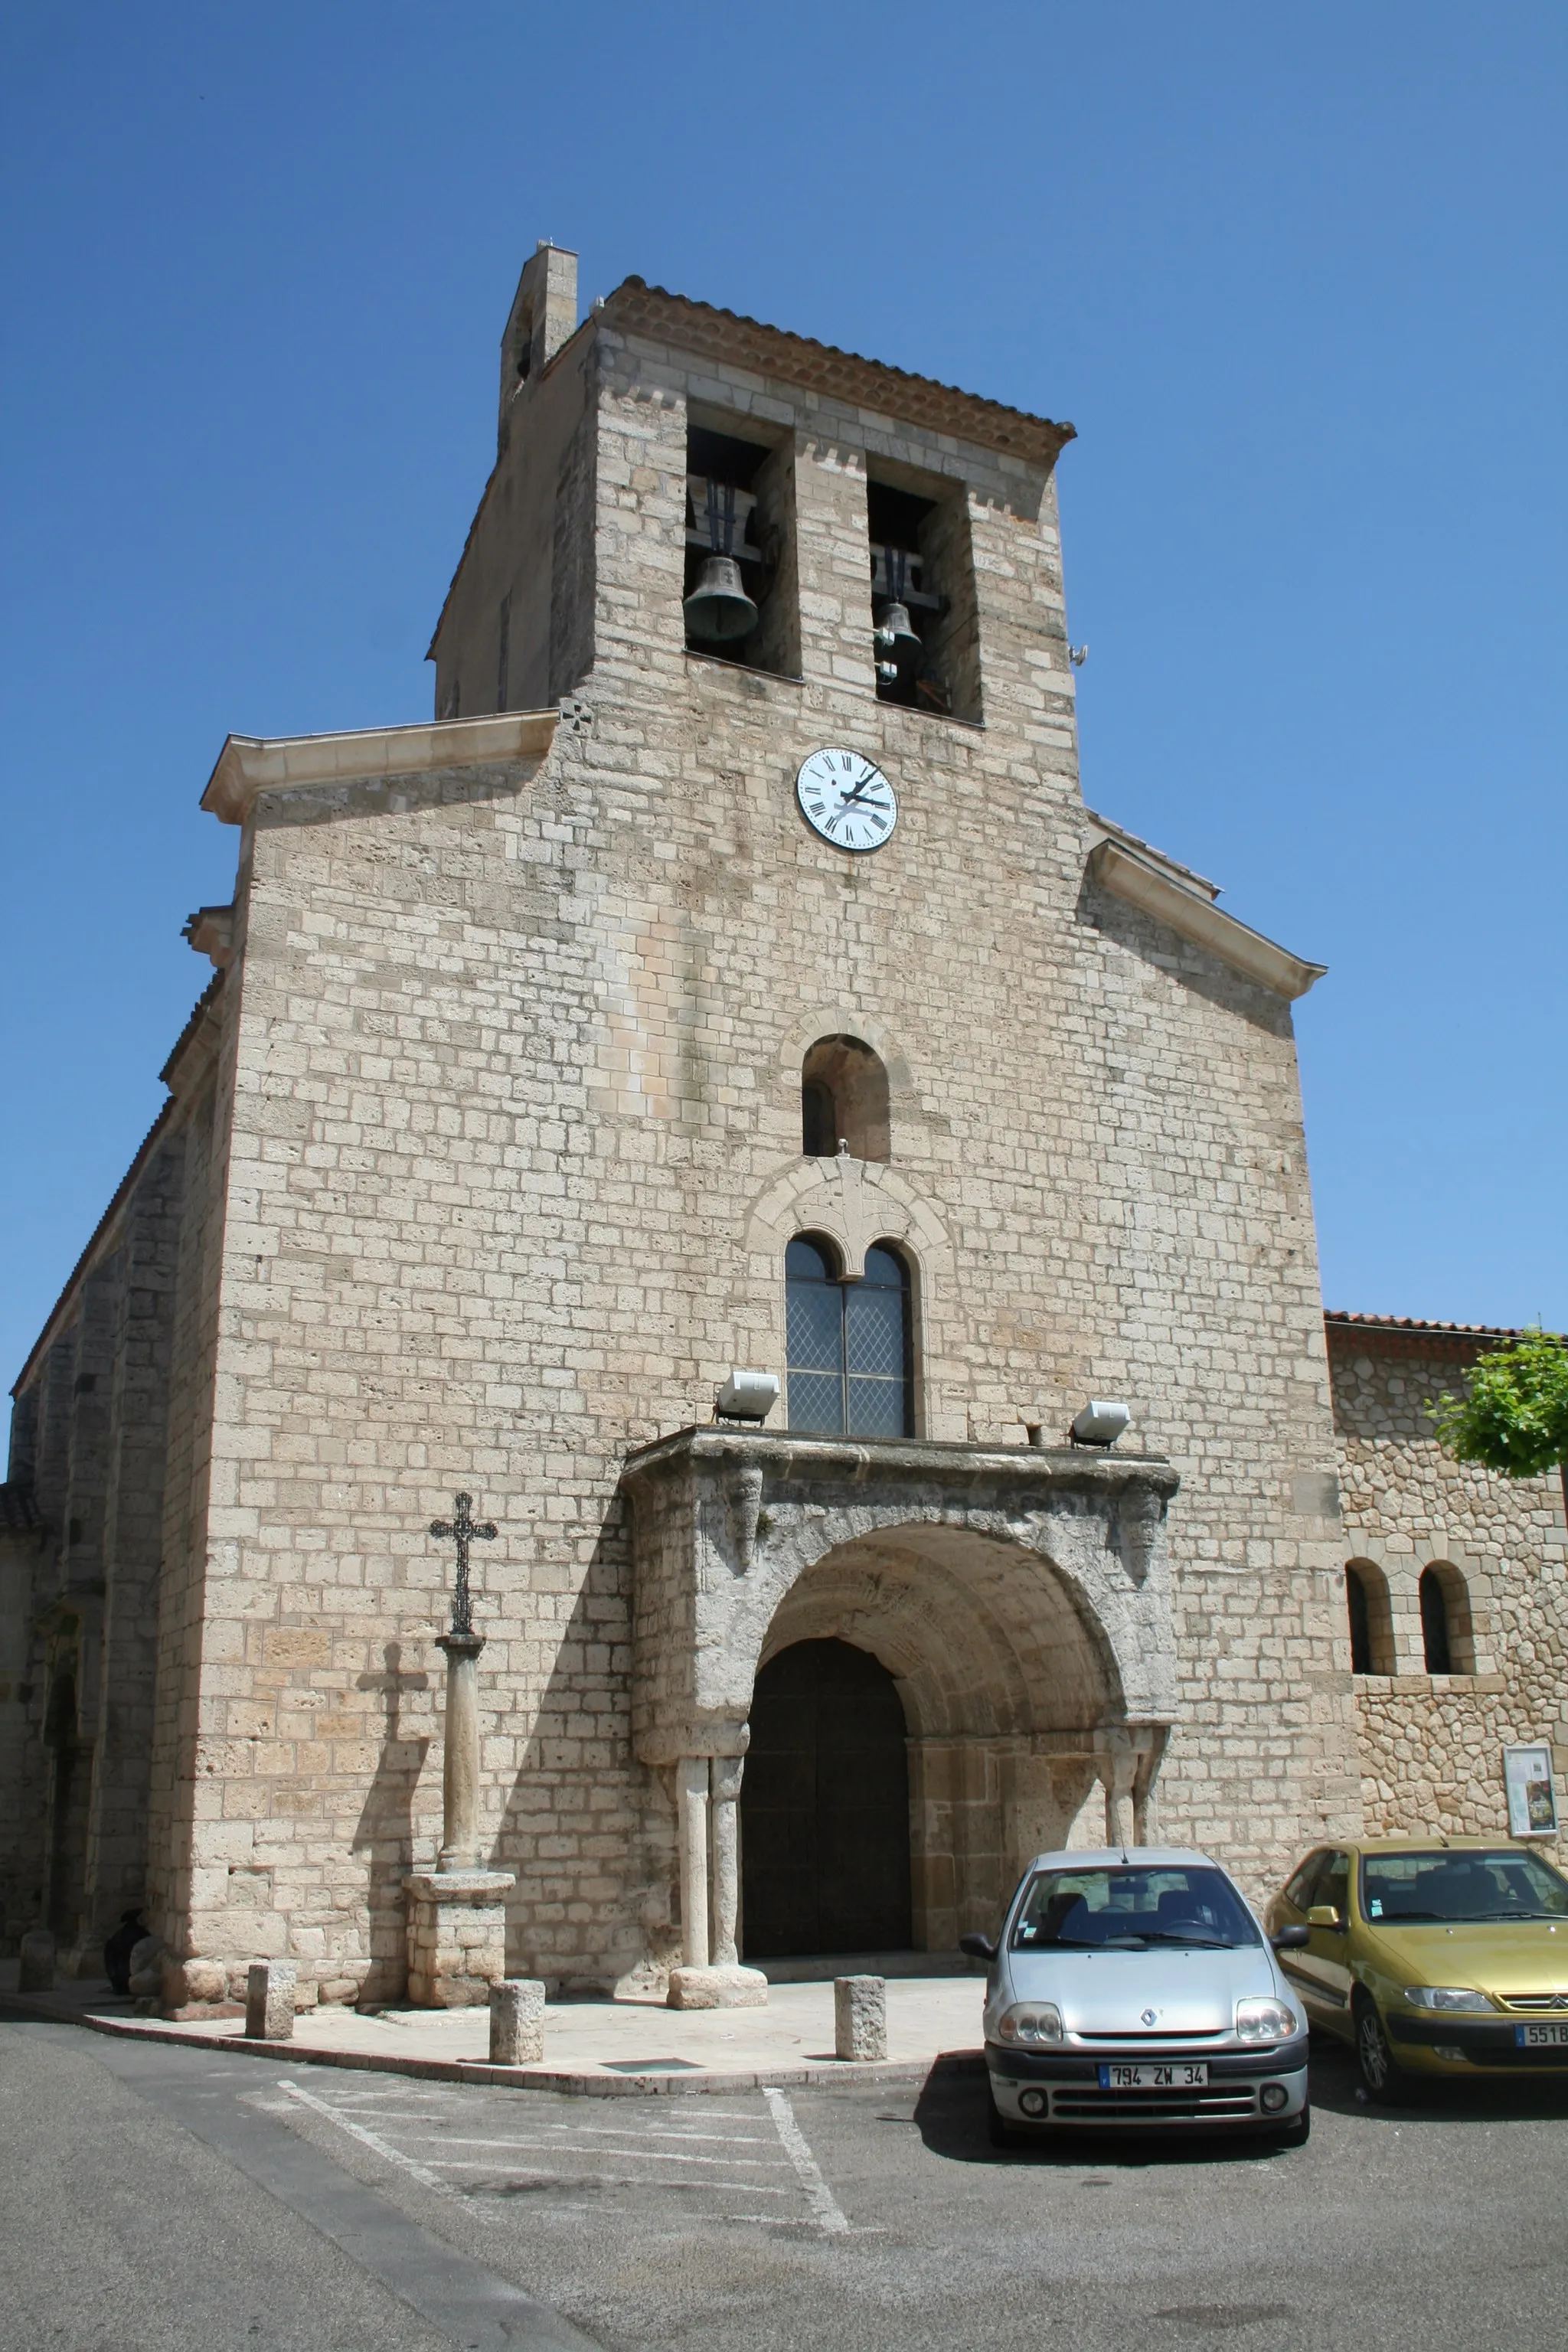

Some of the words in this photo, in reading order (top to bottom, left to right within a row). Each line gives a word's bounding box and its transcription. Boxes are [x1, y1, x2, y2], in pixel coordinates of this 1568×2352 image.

[841, 755, 851, 772] XII
[860, 766, 867, 777] I
[870, 782, 884, 792] II
[1112, 2066, 1141, 2086] 794
[1153, 2067, 1172, 2085] ZW
[1184, 2066, 1204, 2085] 34
